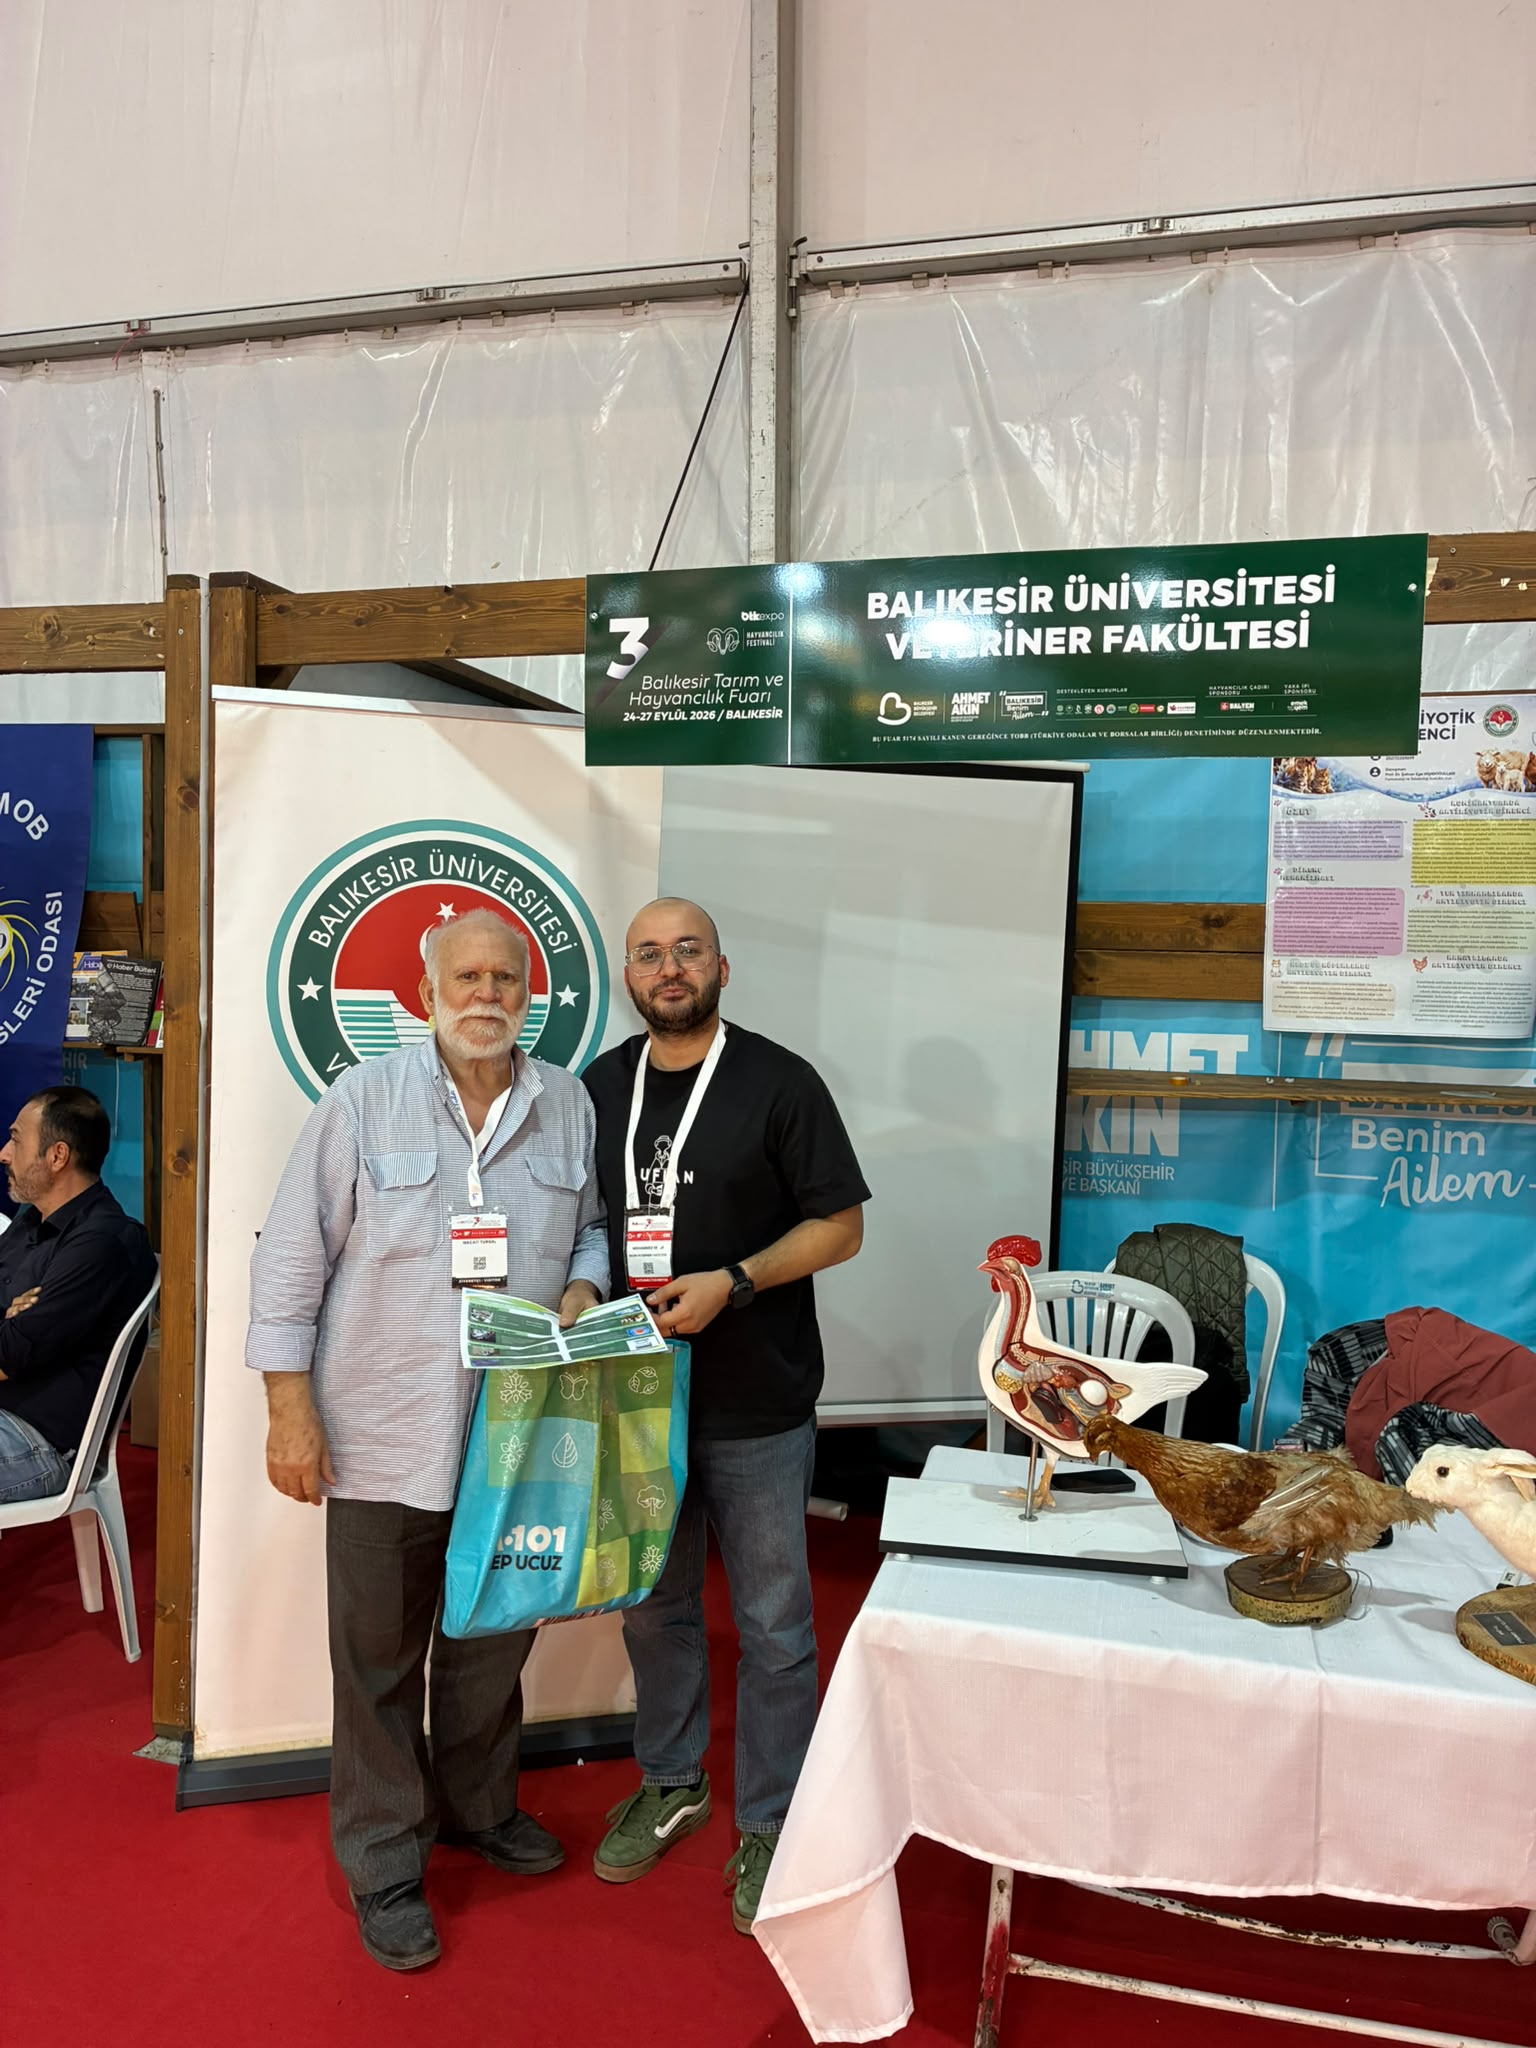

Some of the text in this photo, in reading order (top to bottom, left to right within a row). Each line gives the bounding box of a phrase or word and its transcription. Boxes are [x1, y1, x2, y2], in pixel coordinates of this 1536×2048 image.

[867, 564, 1336, 619] BALIKESİR ÜNİVERSİTESİ
[885, 609, 1310, 660] VERİNER FAKÜLTESİ
[606, 616, 649, 680] 3
[641, 673, 784, 690] Balıkesir Tarım ve
[629, 689, 771, 709] Hayvancılık Fuarı
[951, 692, 991, 704] AHMET
[623, 706, 783, 722] 24-27 EYLÜL 2026 / BALIKESİR
[951, 704, 980, 715] AKIN
[1420, 709, 1475, 725] İYOTİK
[1418, 725, 1456, 740] ENCİ
[308, 848, 578, 954] BALIKESİR ÜNİVERSİTESİ
[0, 891, 63, 1045] SLERİ ODASI
[1068, 1030, 1249, 1075] HMET
[1063, 1095, 1180, 1157] KIN
[1351, 1118, 1486, 1157] Benim
[1085, 1159, 1175, 1181] BÜYÜKŞEHİR
[1380, 1153, 1526, 1208] Ailem
[1080, 1178, 1141, 1195] BAŞKANI
[490, 1554, 563, 1571] EP UCUZ
